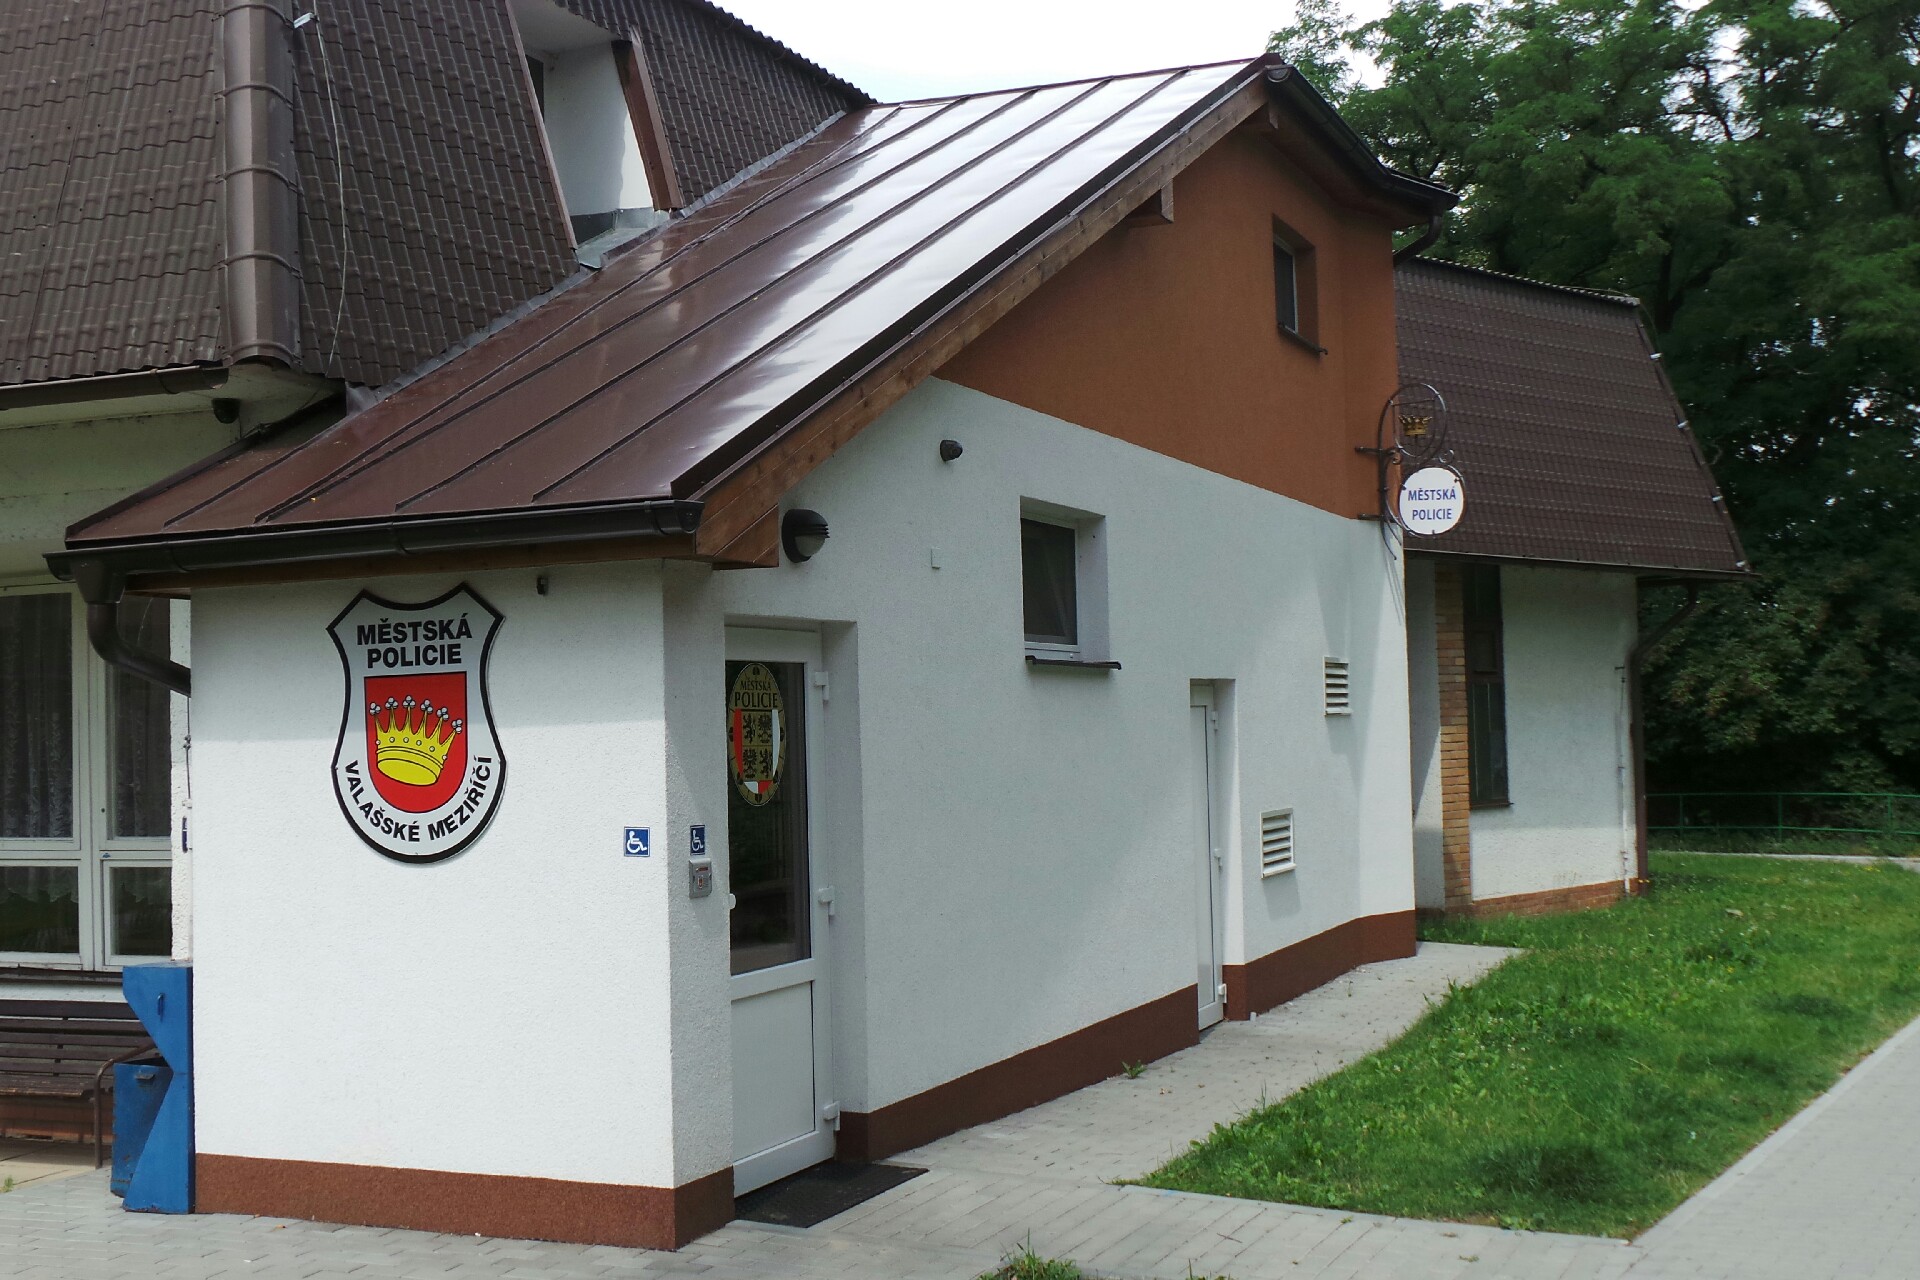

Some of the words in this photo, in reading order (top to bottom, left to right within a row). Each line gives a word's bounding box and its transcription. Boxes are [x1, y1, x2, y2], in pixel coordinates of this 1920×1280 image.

[1408, 486, 1456, 501] MĚSTSKÁ
[1412, 508, 1452, 520] POLICIE
[357, 613, 472, 646] MĚSTSKÁ
[367, 643, 462, 668] POLICIE
[740, 678, 772, 691] MĚSTSKÁ
[734, 692, 778, 708] POLICIE
[345, 760, 420, 842] VALAŠSKÉ
[427, 755, 493, 840] MEZIŘÍČÍ
